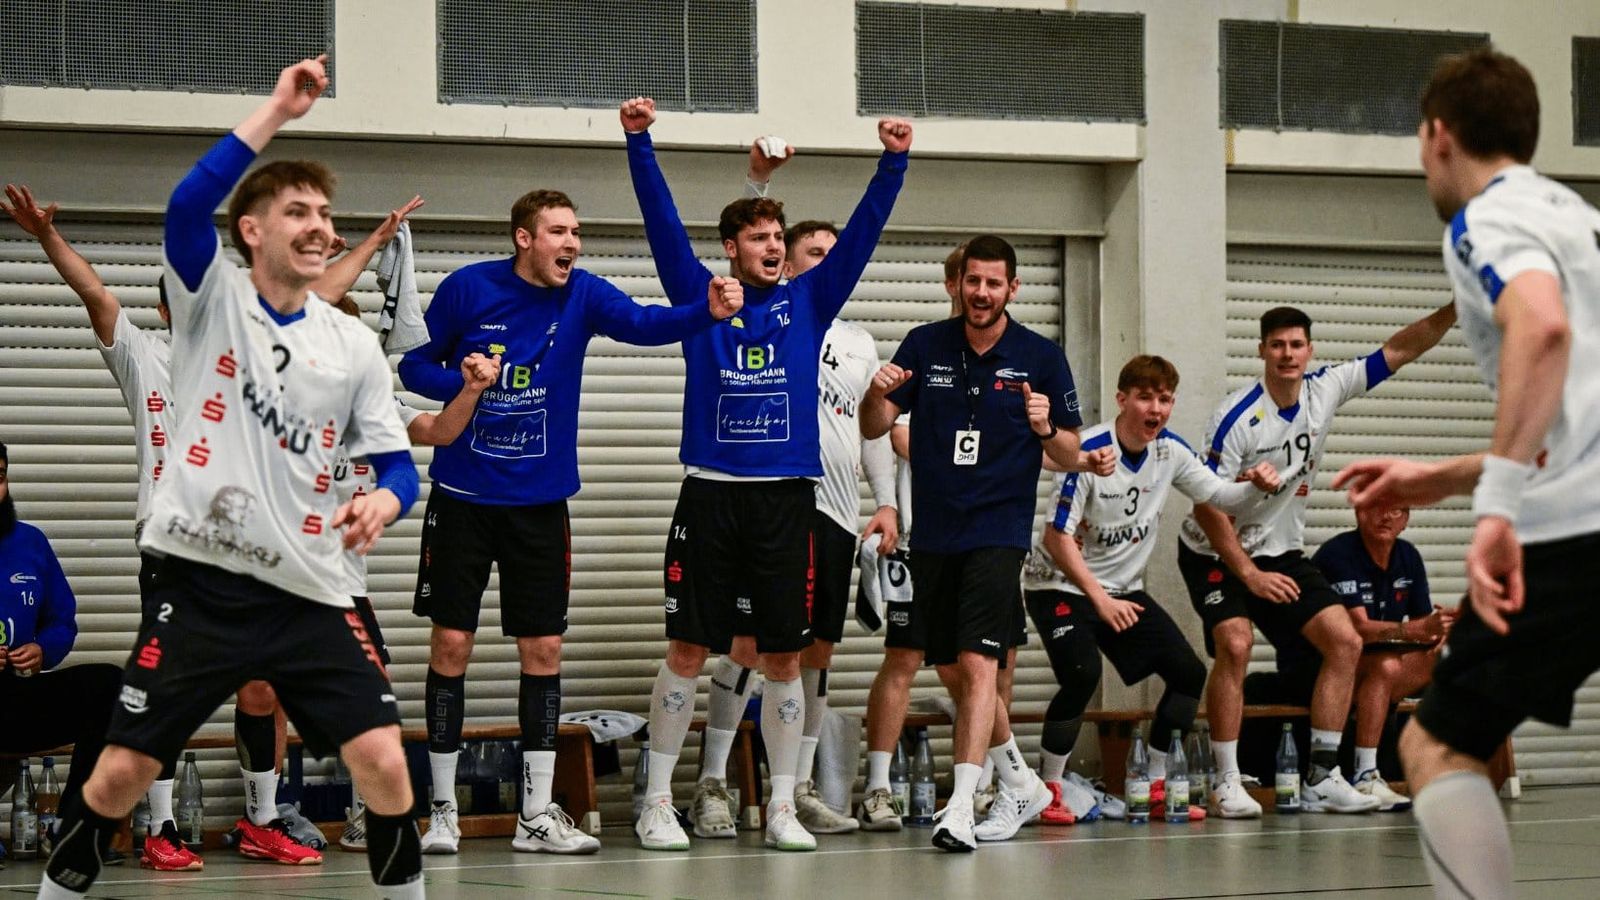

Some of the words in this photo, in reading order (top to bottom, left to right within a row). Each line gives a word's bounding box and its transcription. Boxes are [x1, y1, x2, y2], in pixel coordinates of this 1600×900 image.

[958, 436, 976, 454] C
[1281, 432, 1311, 466] 19
[1124, 486, 1140, 516] 3
[674, 525, 687, 541] 14
[21, 591, 35, 606] 16
[157, 603, 174, 623] 2
